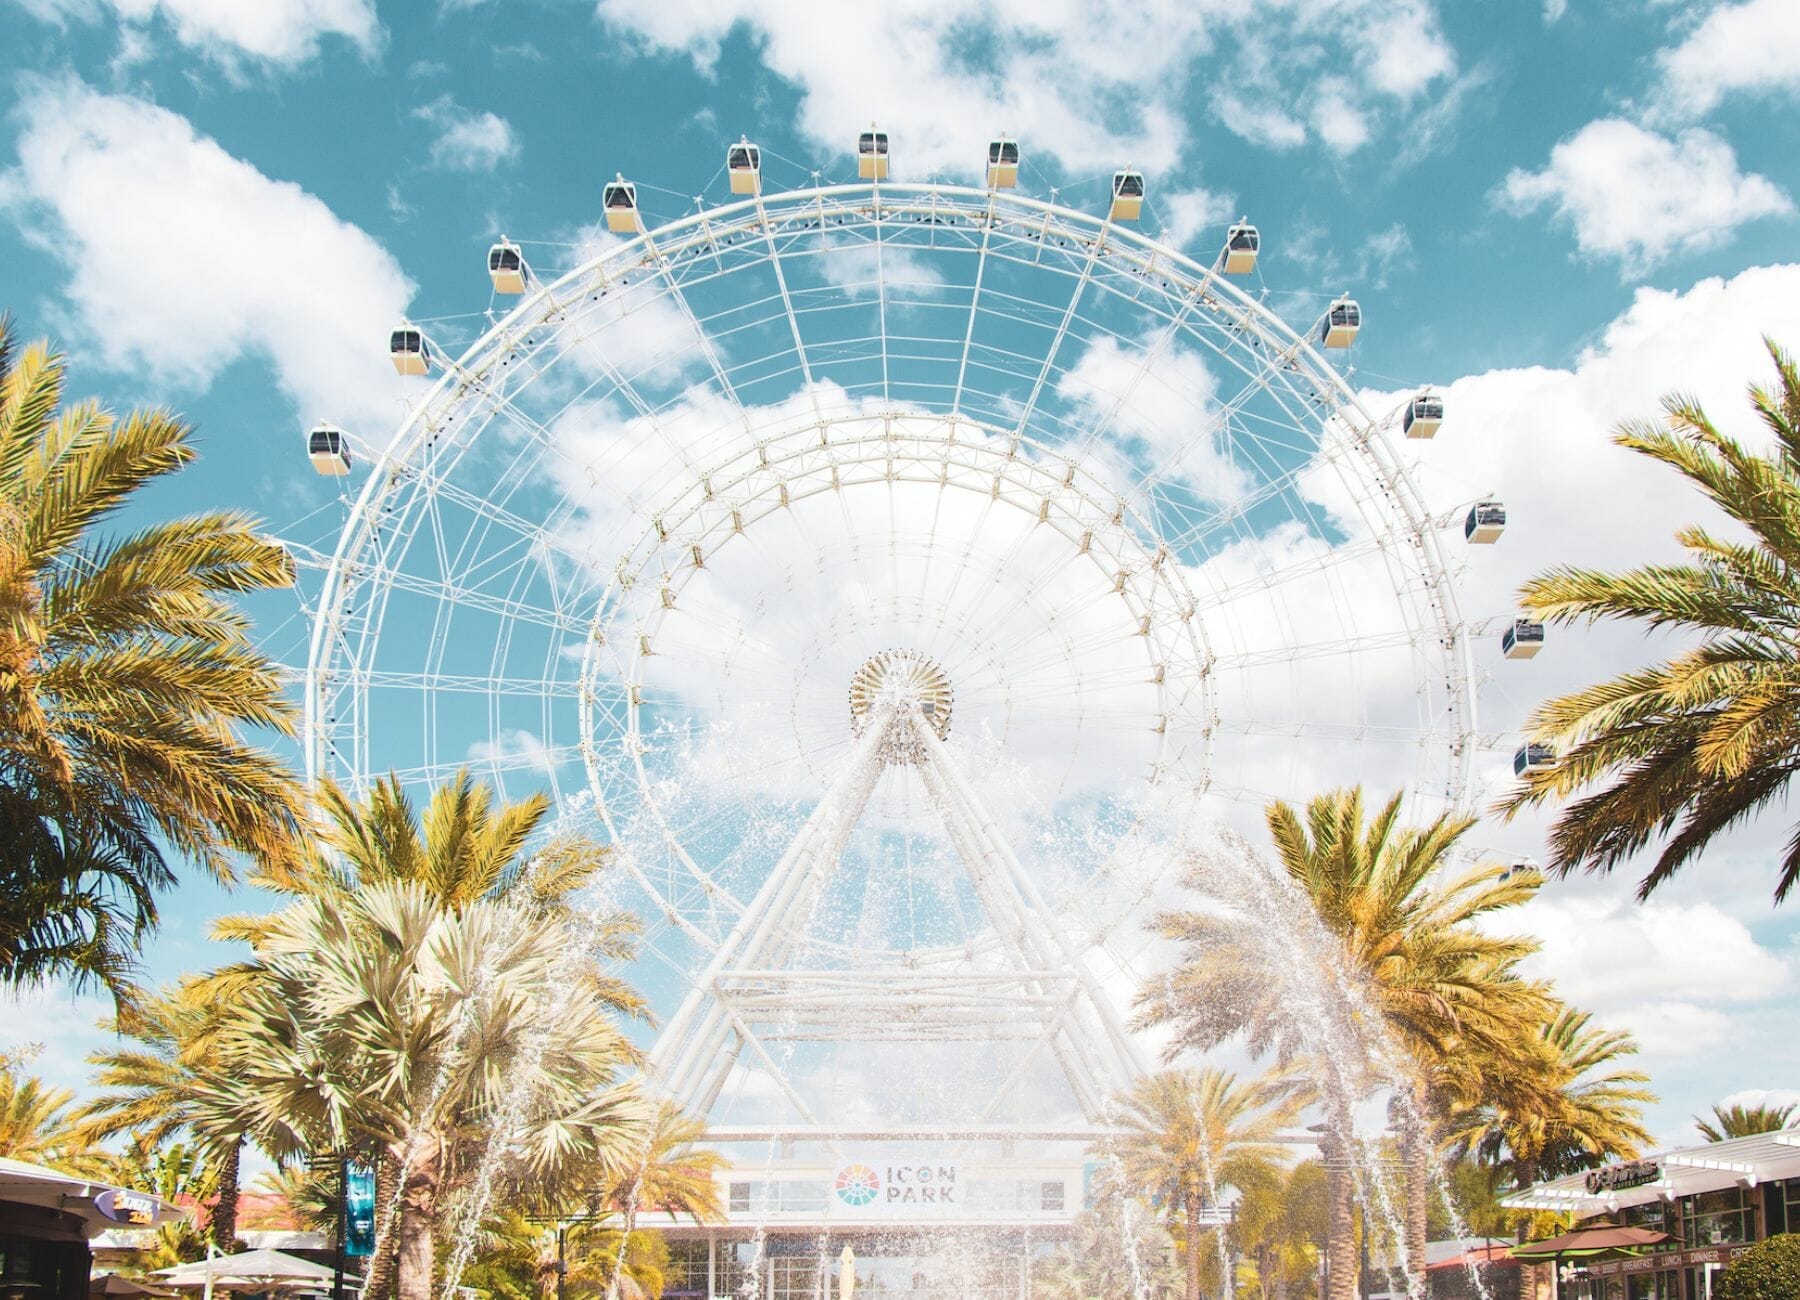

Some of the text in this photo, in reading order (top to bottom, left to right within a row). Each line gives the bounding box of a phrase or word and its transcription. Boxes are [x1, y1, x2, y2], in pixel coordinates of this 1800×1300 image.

[887, 1166, 955, 1183] ICON
[887, 1187, 954, 1203] PARK
[1622, 1258, 1654, 1271] BREAKFAST
[1661, 1255, 1681, 1267] LUNCH
[1690, 1250, 1719, 1263] DINNER
